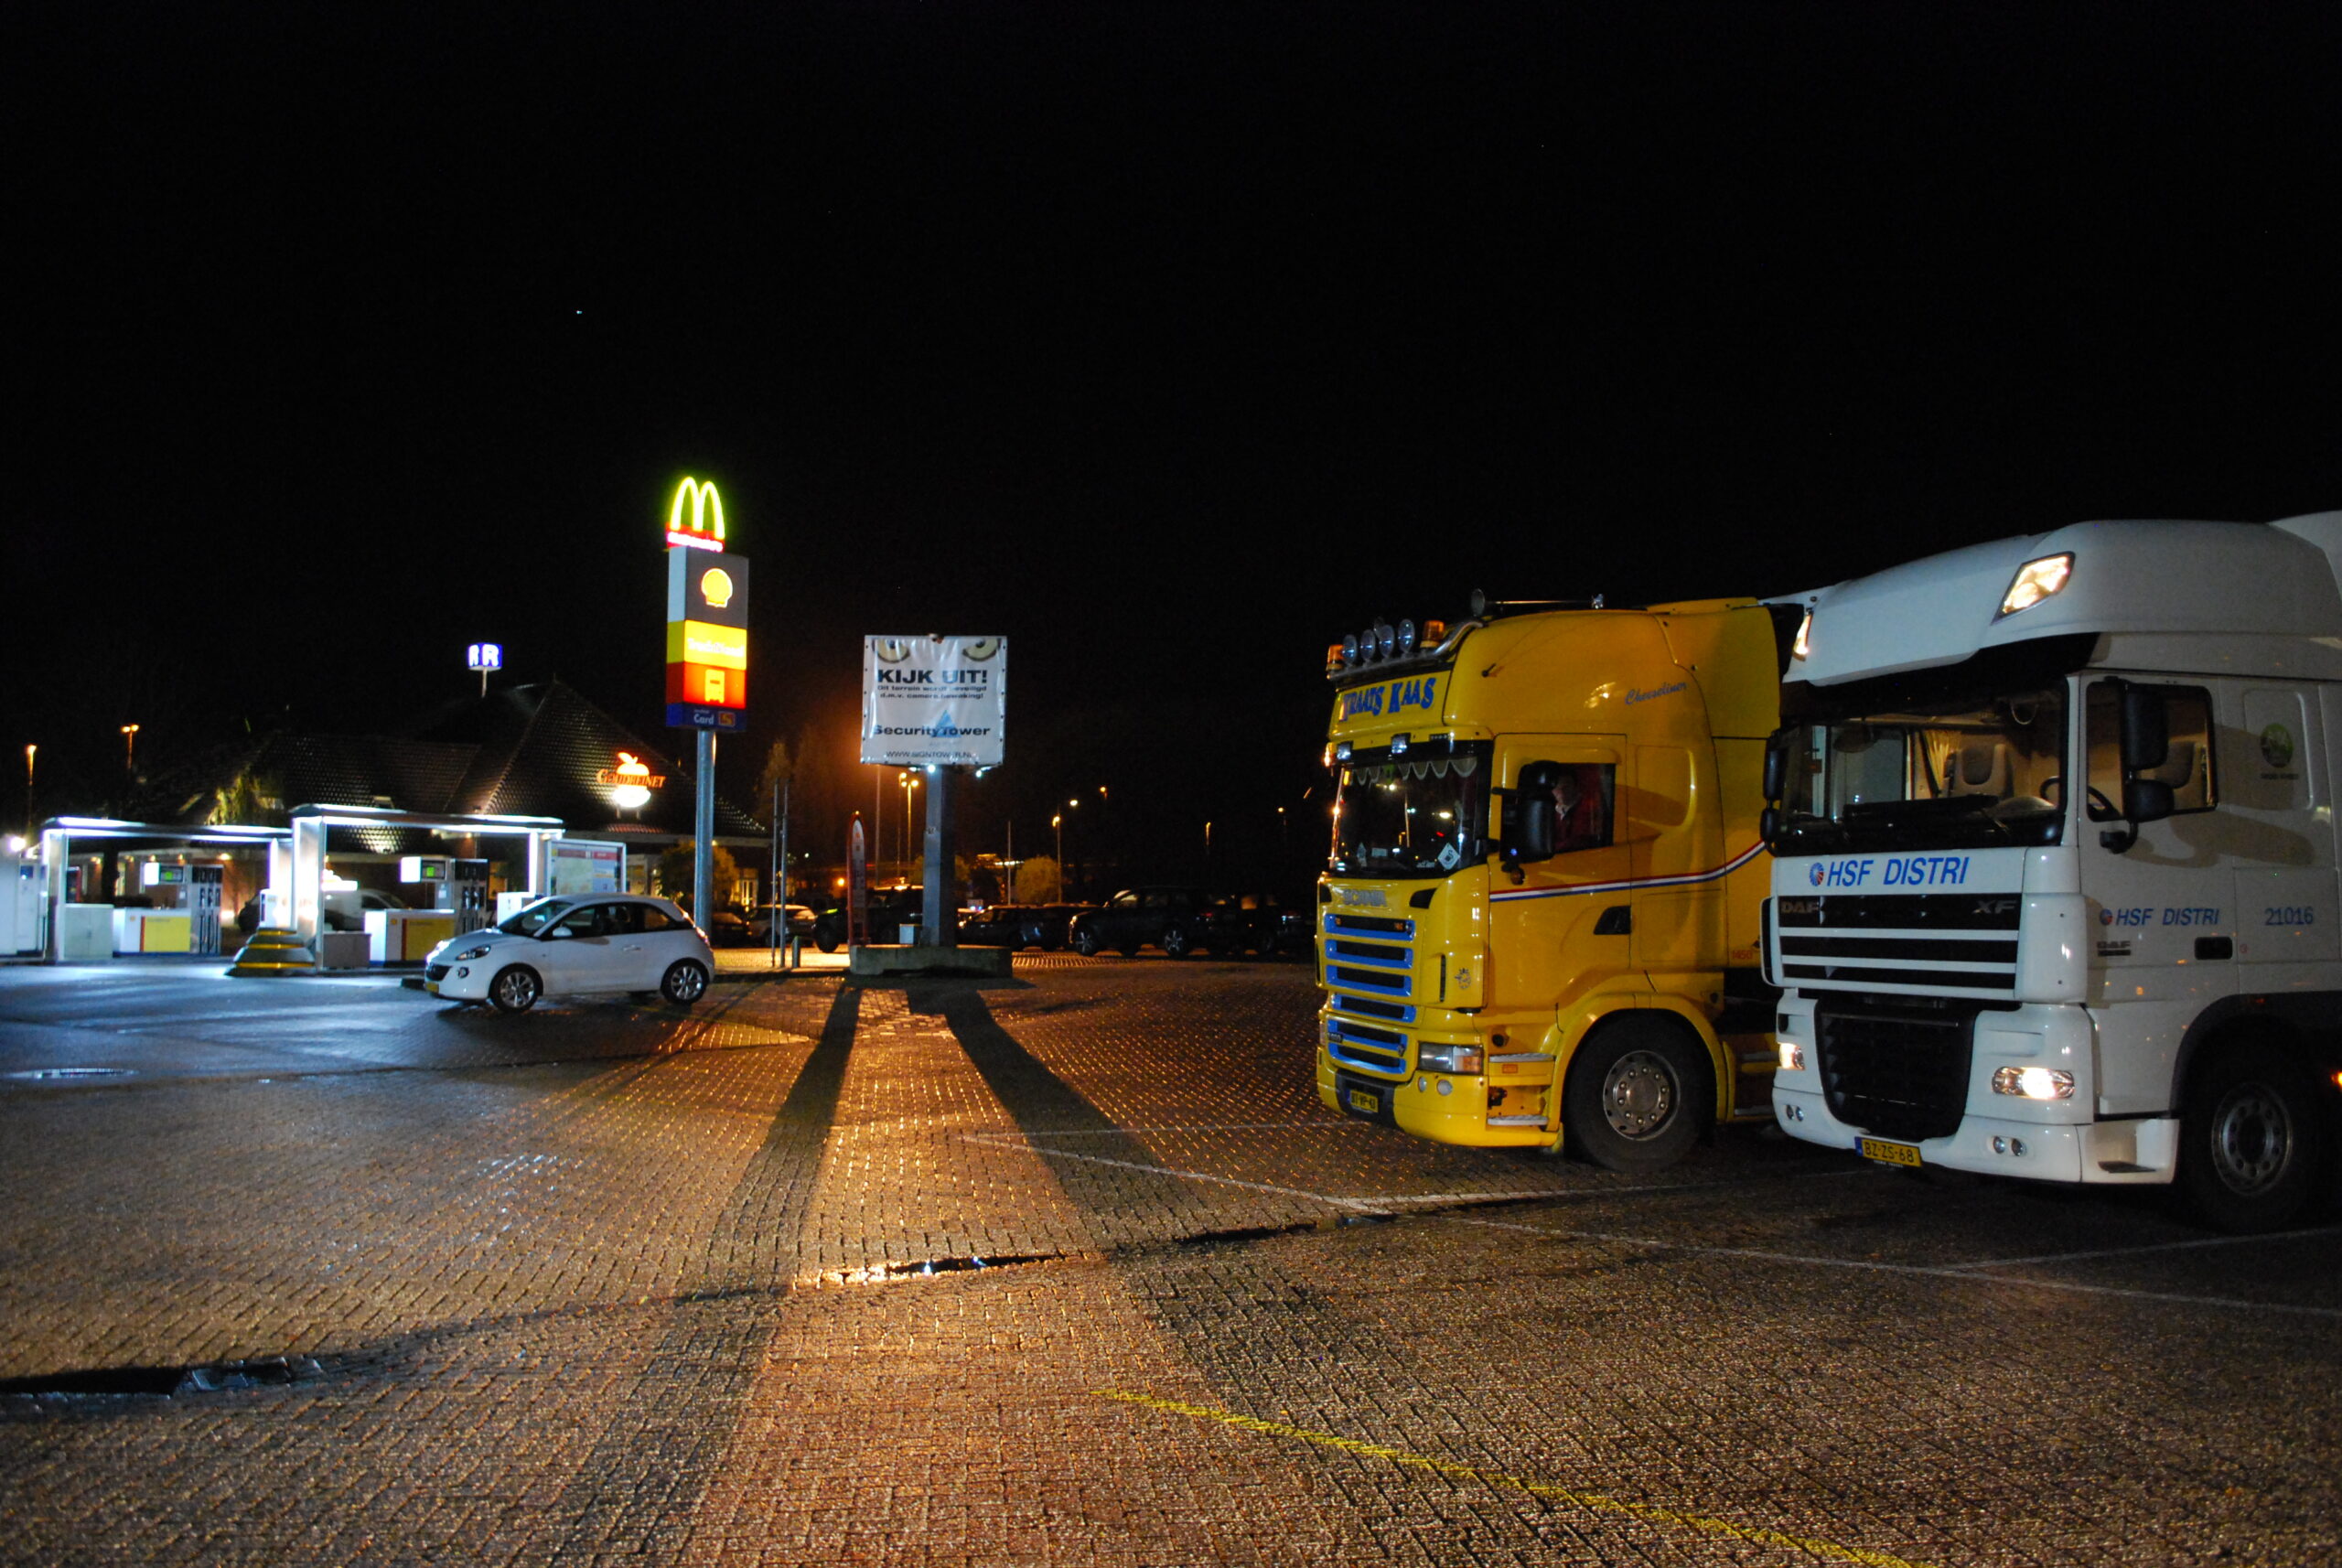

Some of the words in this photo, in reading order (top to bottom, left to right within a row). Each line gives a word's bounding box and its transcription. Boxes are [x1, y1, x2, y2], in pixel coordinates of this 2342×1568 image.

[877, 670, 933, 683] KIJK
[942, 670, 988, 683] UIT!
[1387, 678, 1437, 714] KAAS
[1827, 860, 1874, 886] HSF
[1884, 856, 1970, 886] DISTRI
[1343, 888, 1388, 908] SCANIA
[1974, 899, 2017, 915] XF
[1780, 901, 1820, 914] DAF
[2264, 907, 2314, 926] 21016
[2116, 908, 2154, 926] HSF
[2163, 908, 2219, 926] DISTRI
[2097, 940, 2131, 949] DAF
[1864, 1142, 1914, 1163] BZ-ZS-68
